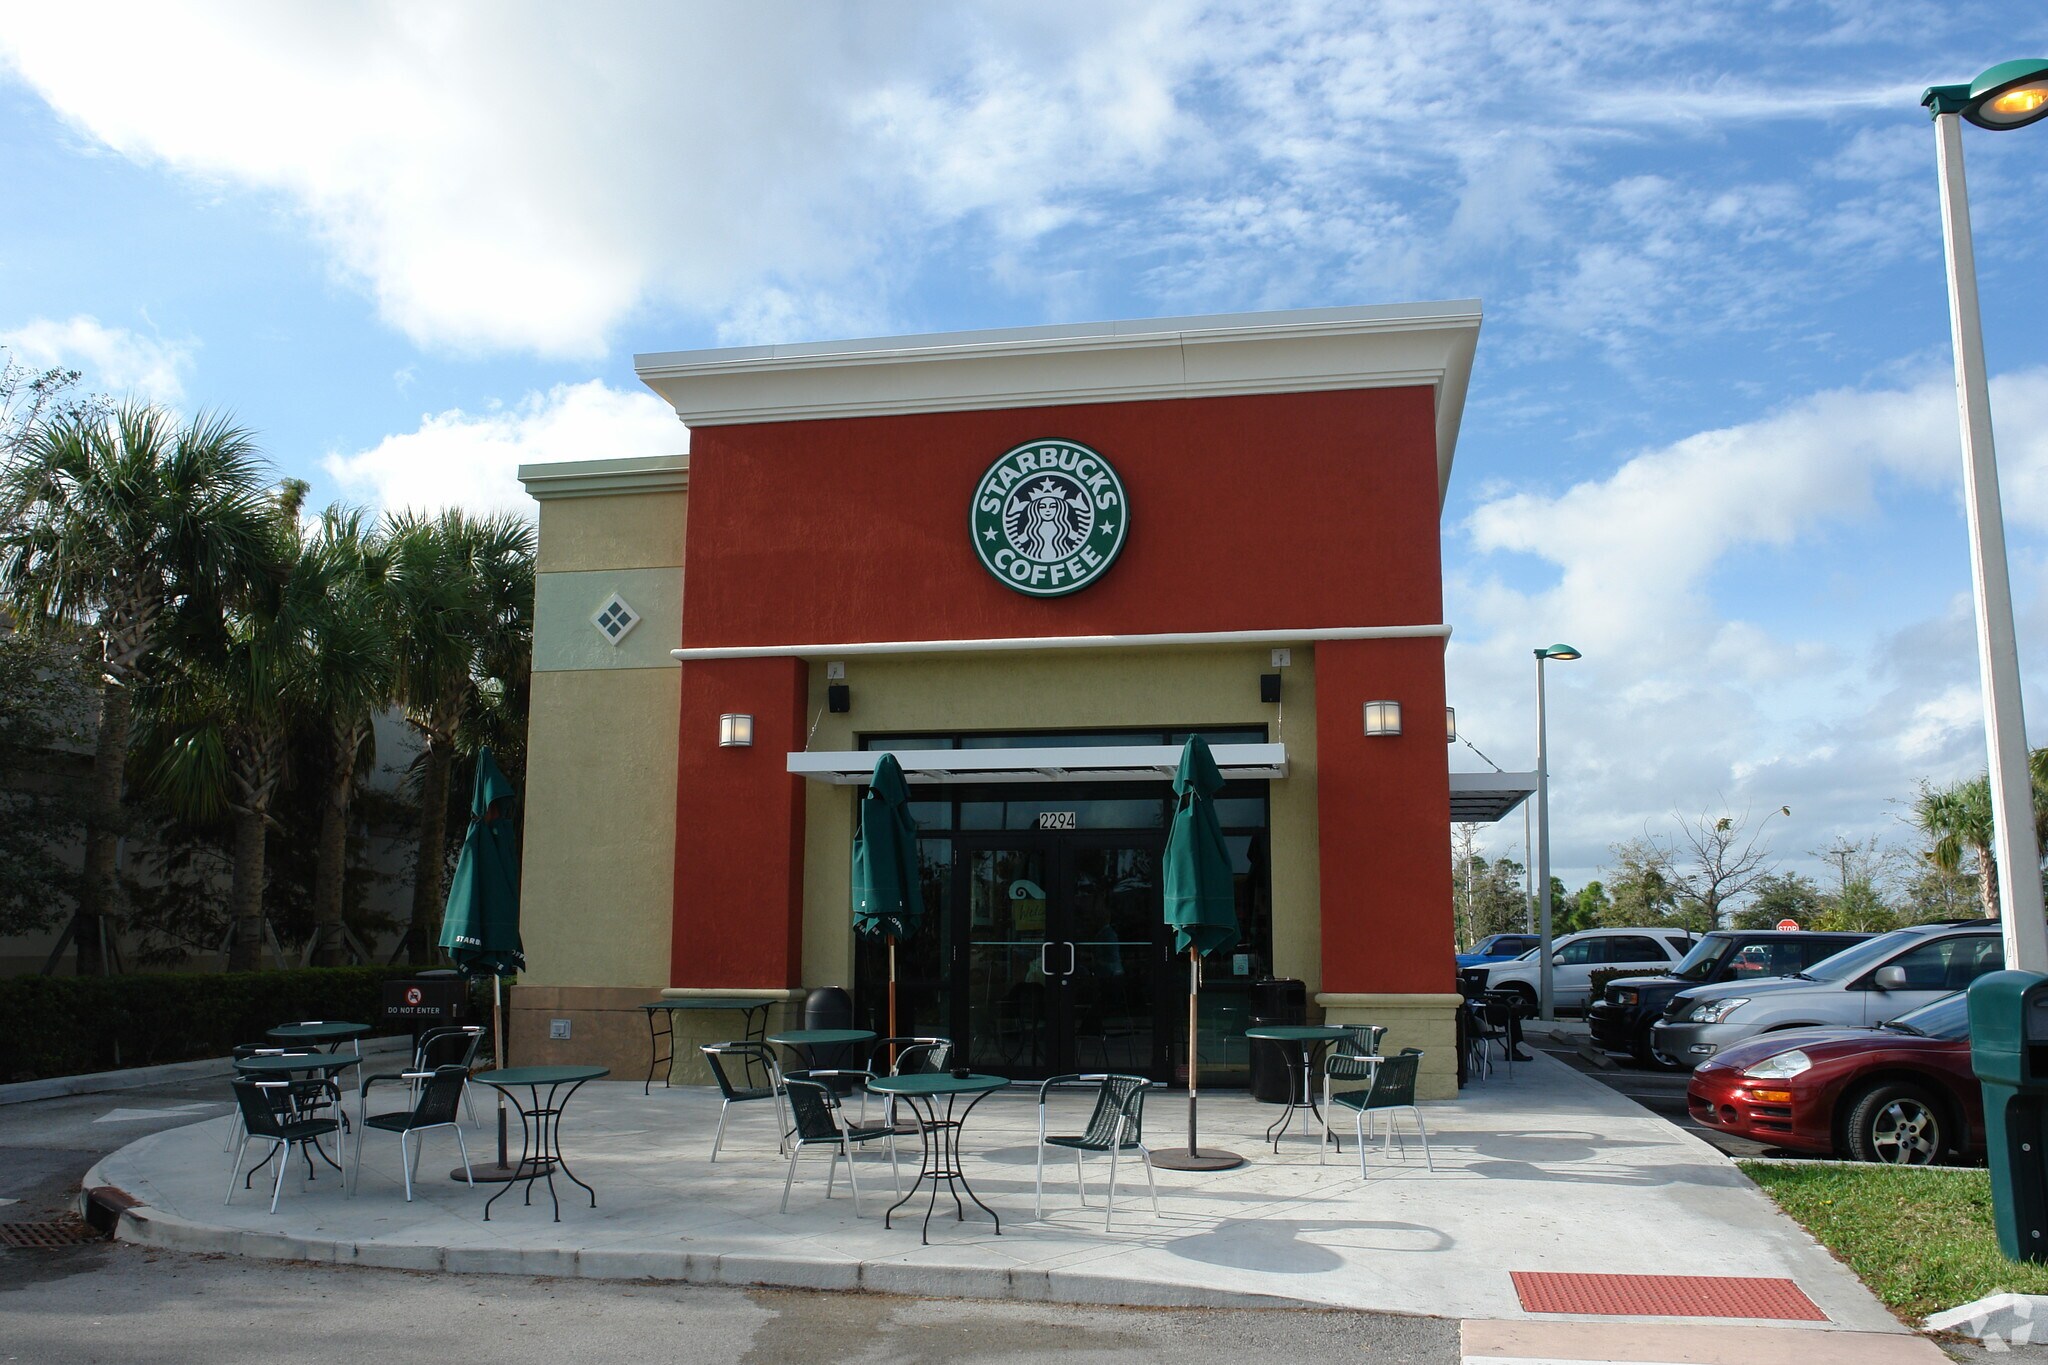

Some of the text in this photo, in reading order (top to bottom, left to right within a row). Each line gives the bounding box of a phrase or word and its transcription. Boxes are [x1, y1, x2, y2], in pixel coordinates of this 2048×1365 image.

[980, 447, 1118, 515] STARBUCKS
[994, 544, 1103, 586] COFFEE
[1040, 812, 1075, 829] 2294
[455, 935, 482, 947] STARB
[387, 1006, 440, 1014] DO NOT ENTER
